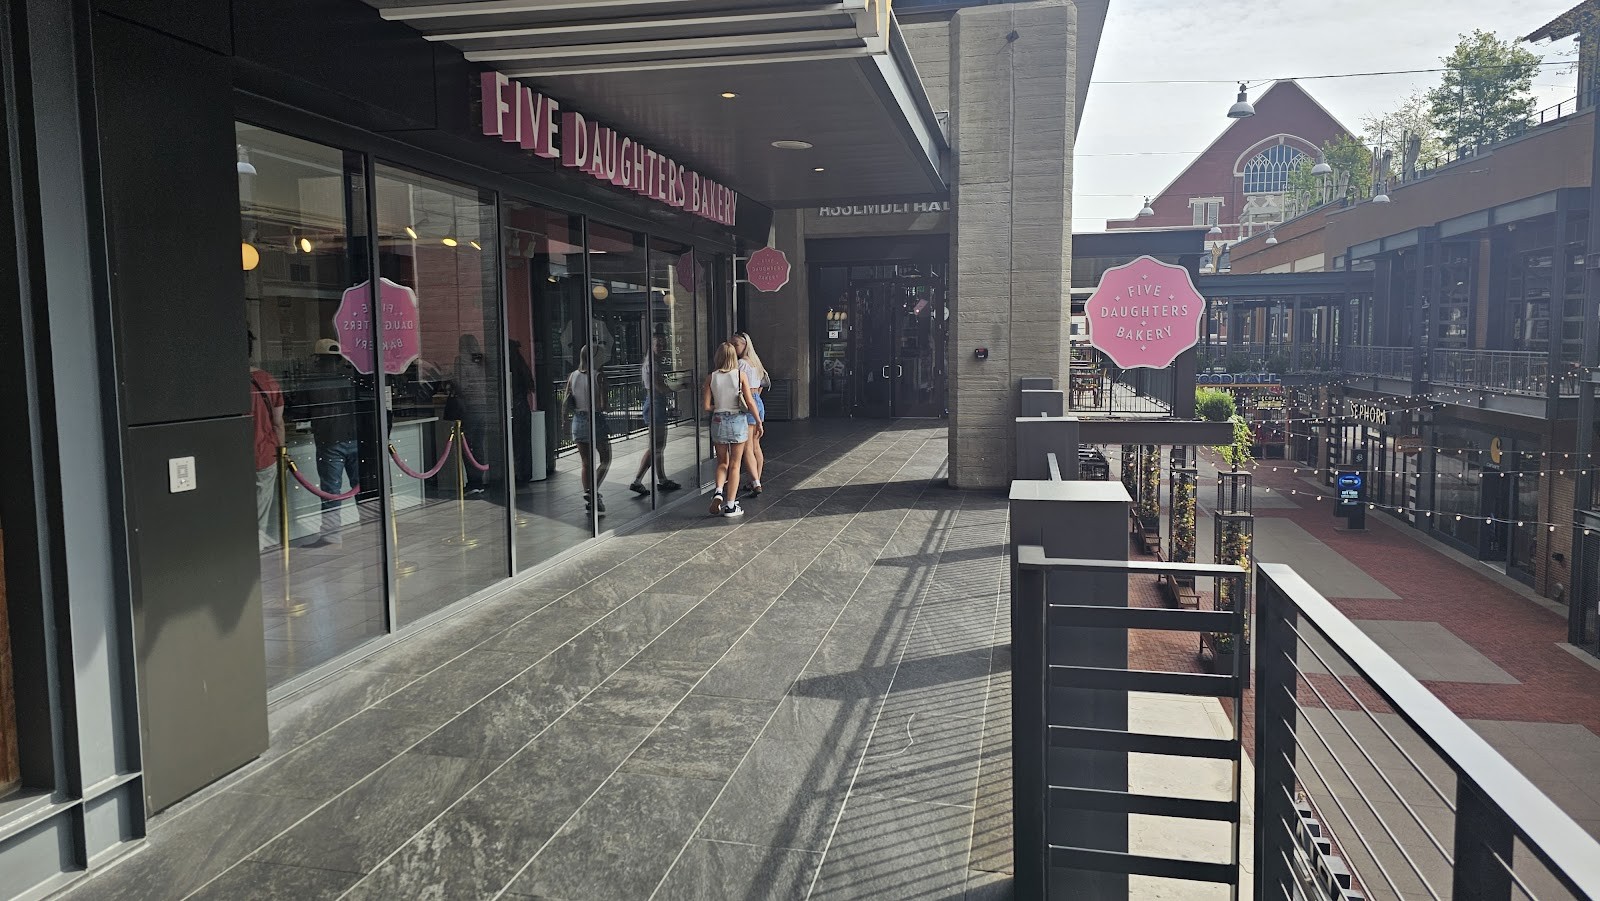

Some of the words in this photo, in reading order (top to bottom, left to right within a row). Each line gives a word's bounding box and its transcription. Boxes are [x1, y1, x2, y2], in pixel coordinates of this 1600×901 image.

[481, 71, 560, 158] FIVE
[564, 111, 685, 206] DAUGHTERS
[687, 170, 738, 226] BAKERY
[1127, 284, 1162, 298] FIVE
[1101, 304, 1189, 318] DAUGHTERS
[1116, 325, 1173, 342] BAKERY
[1350, 403, 1387, 425] SEPHORA
